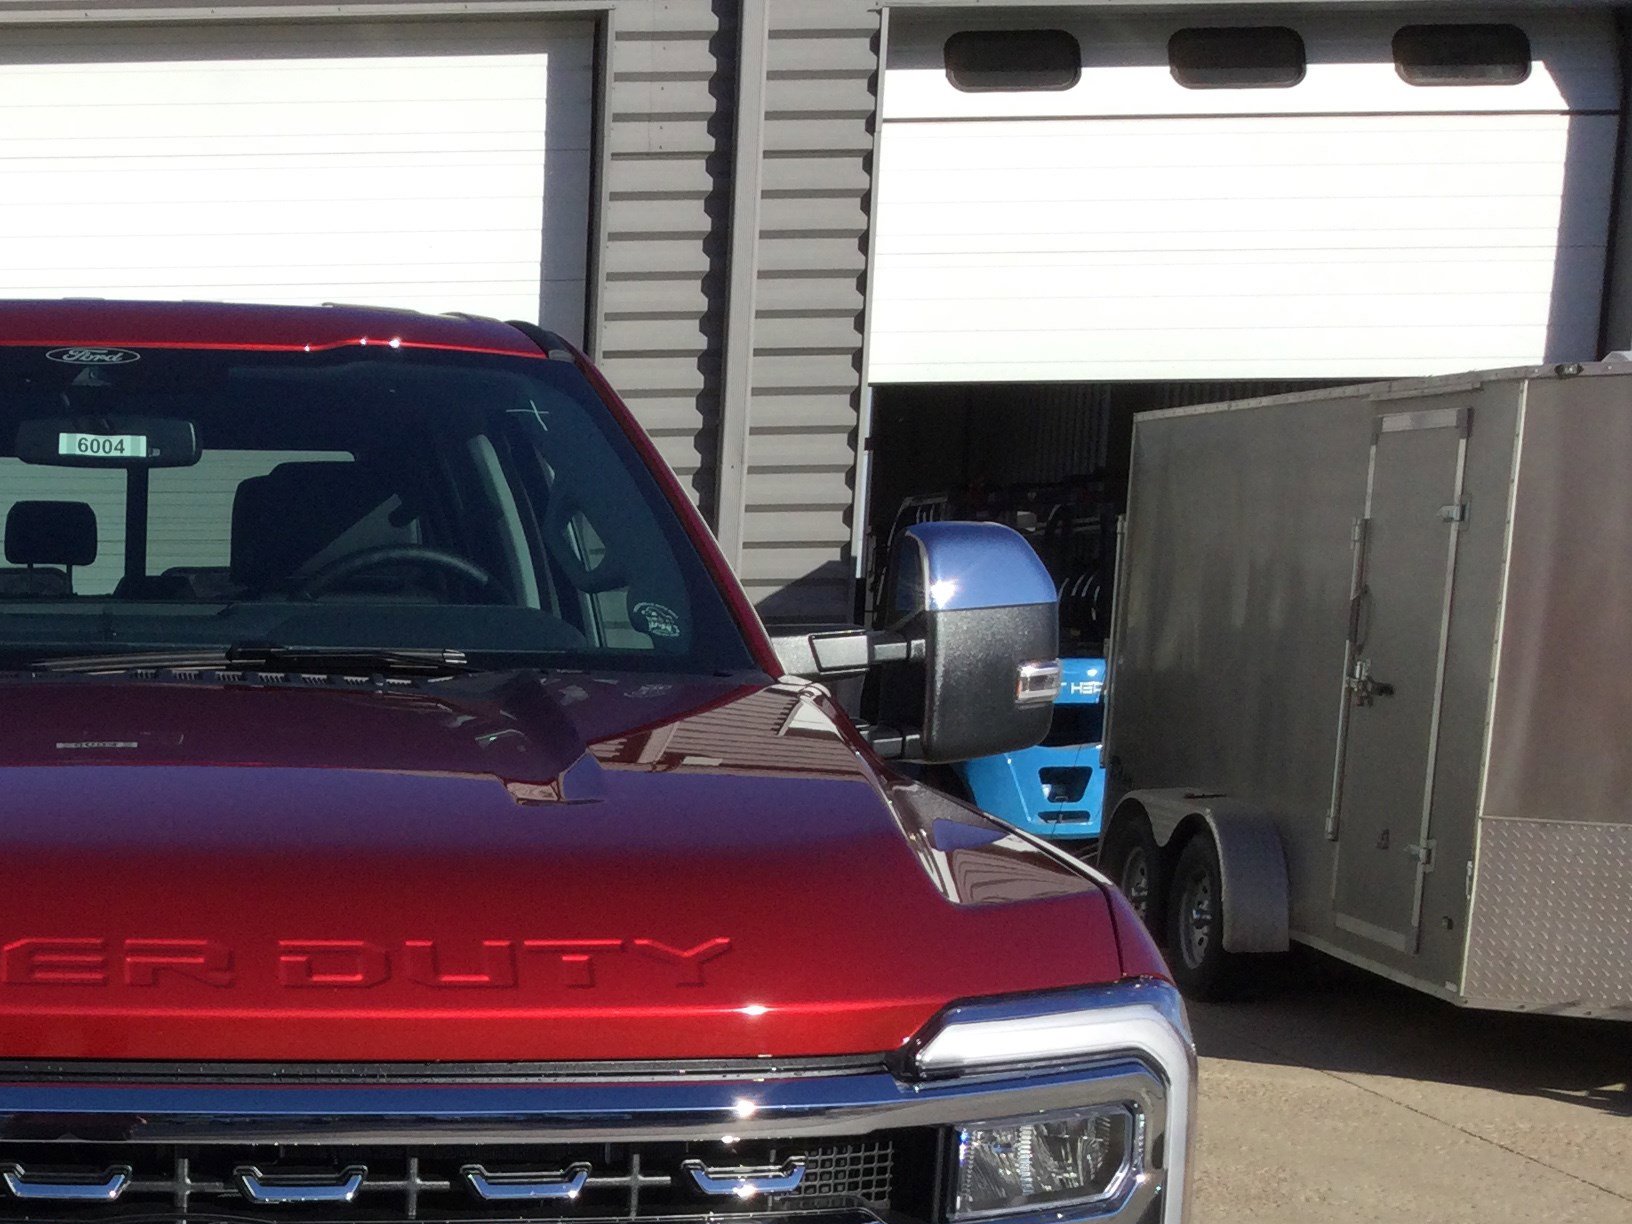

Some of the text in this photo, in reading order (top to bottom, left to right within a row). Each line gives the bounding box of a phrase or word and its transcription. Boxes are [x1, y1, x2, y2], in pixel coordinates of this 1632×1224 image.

[62, 348, 124, 362] Ford
[77, 437, 125, 454] 6004
[277, 936, 732, 989] DUTY
